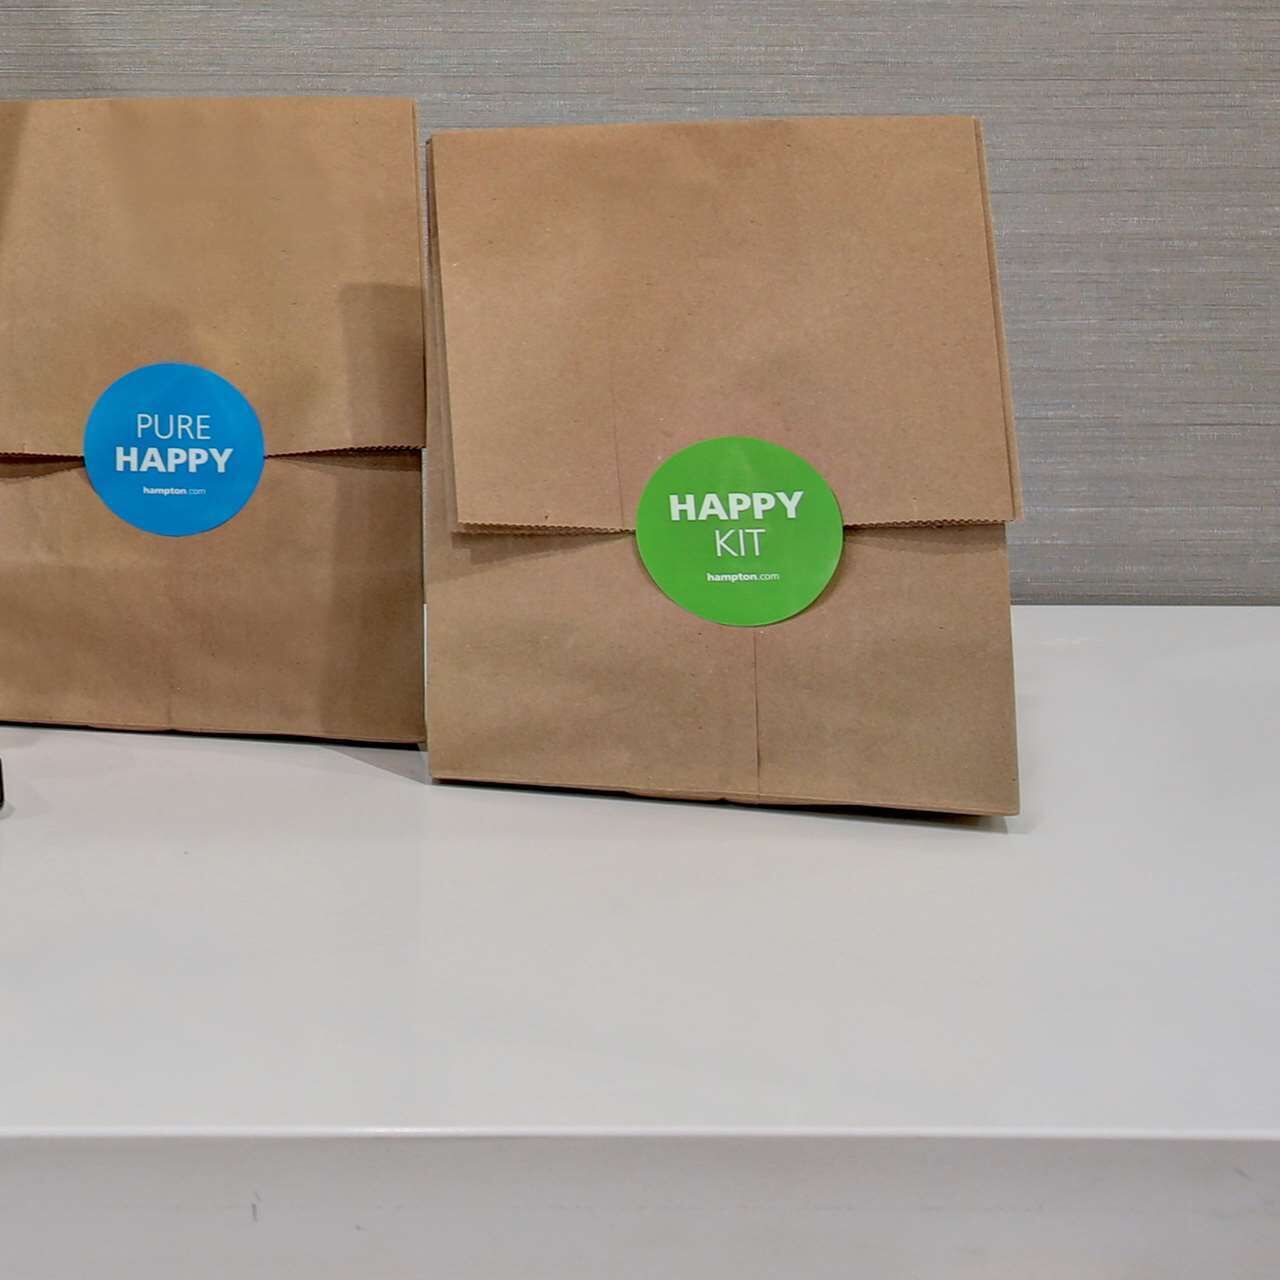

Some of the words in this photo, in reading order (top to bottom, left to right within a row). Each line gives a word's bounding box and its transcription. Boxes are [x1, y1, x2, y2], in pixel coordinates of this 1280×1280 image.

[136, 413, 211, 440] PURE
[115, 446, 233, 473] HAPPY
[669, 491, 804, 521] HAPPY
[715, 528, 766, 557] KIT
[706, 572, 780, 583] hampton.com
